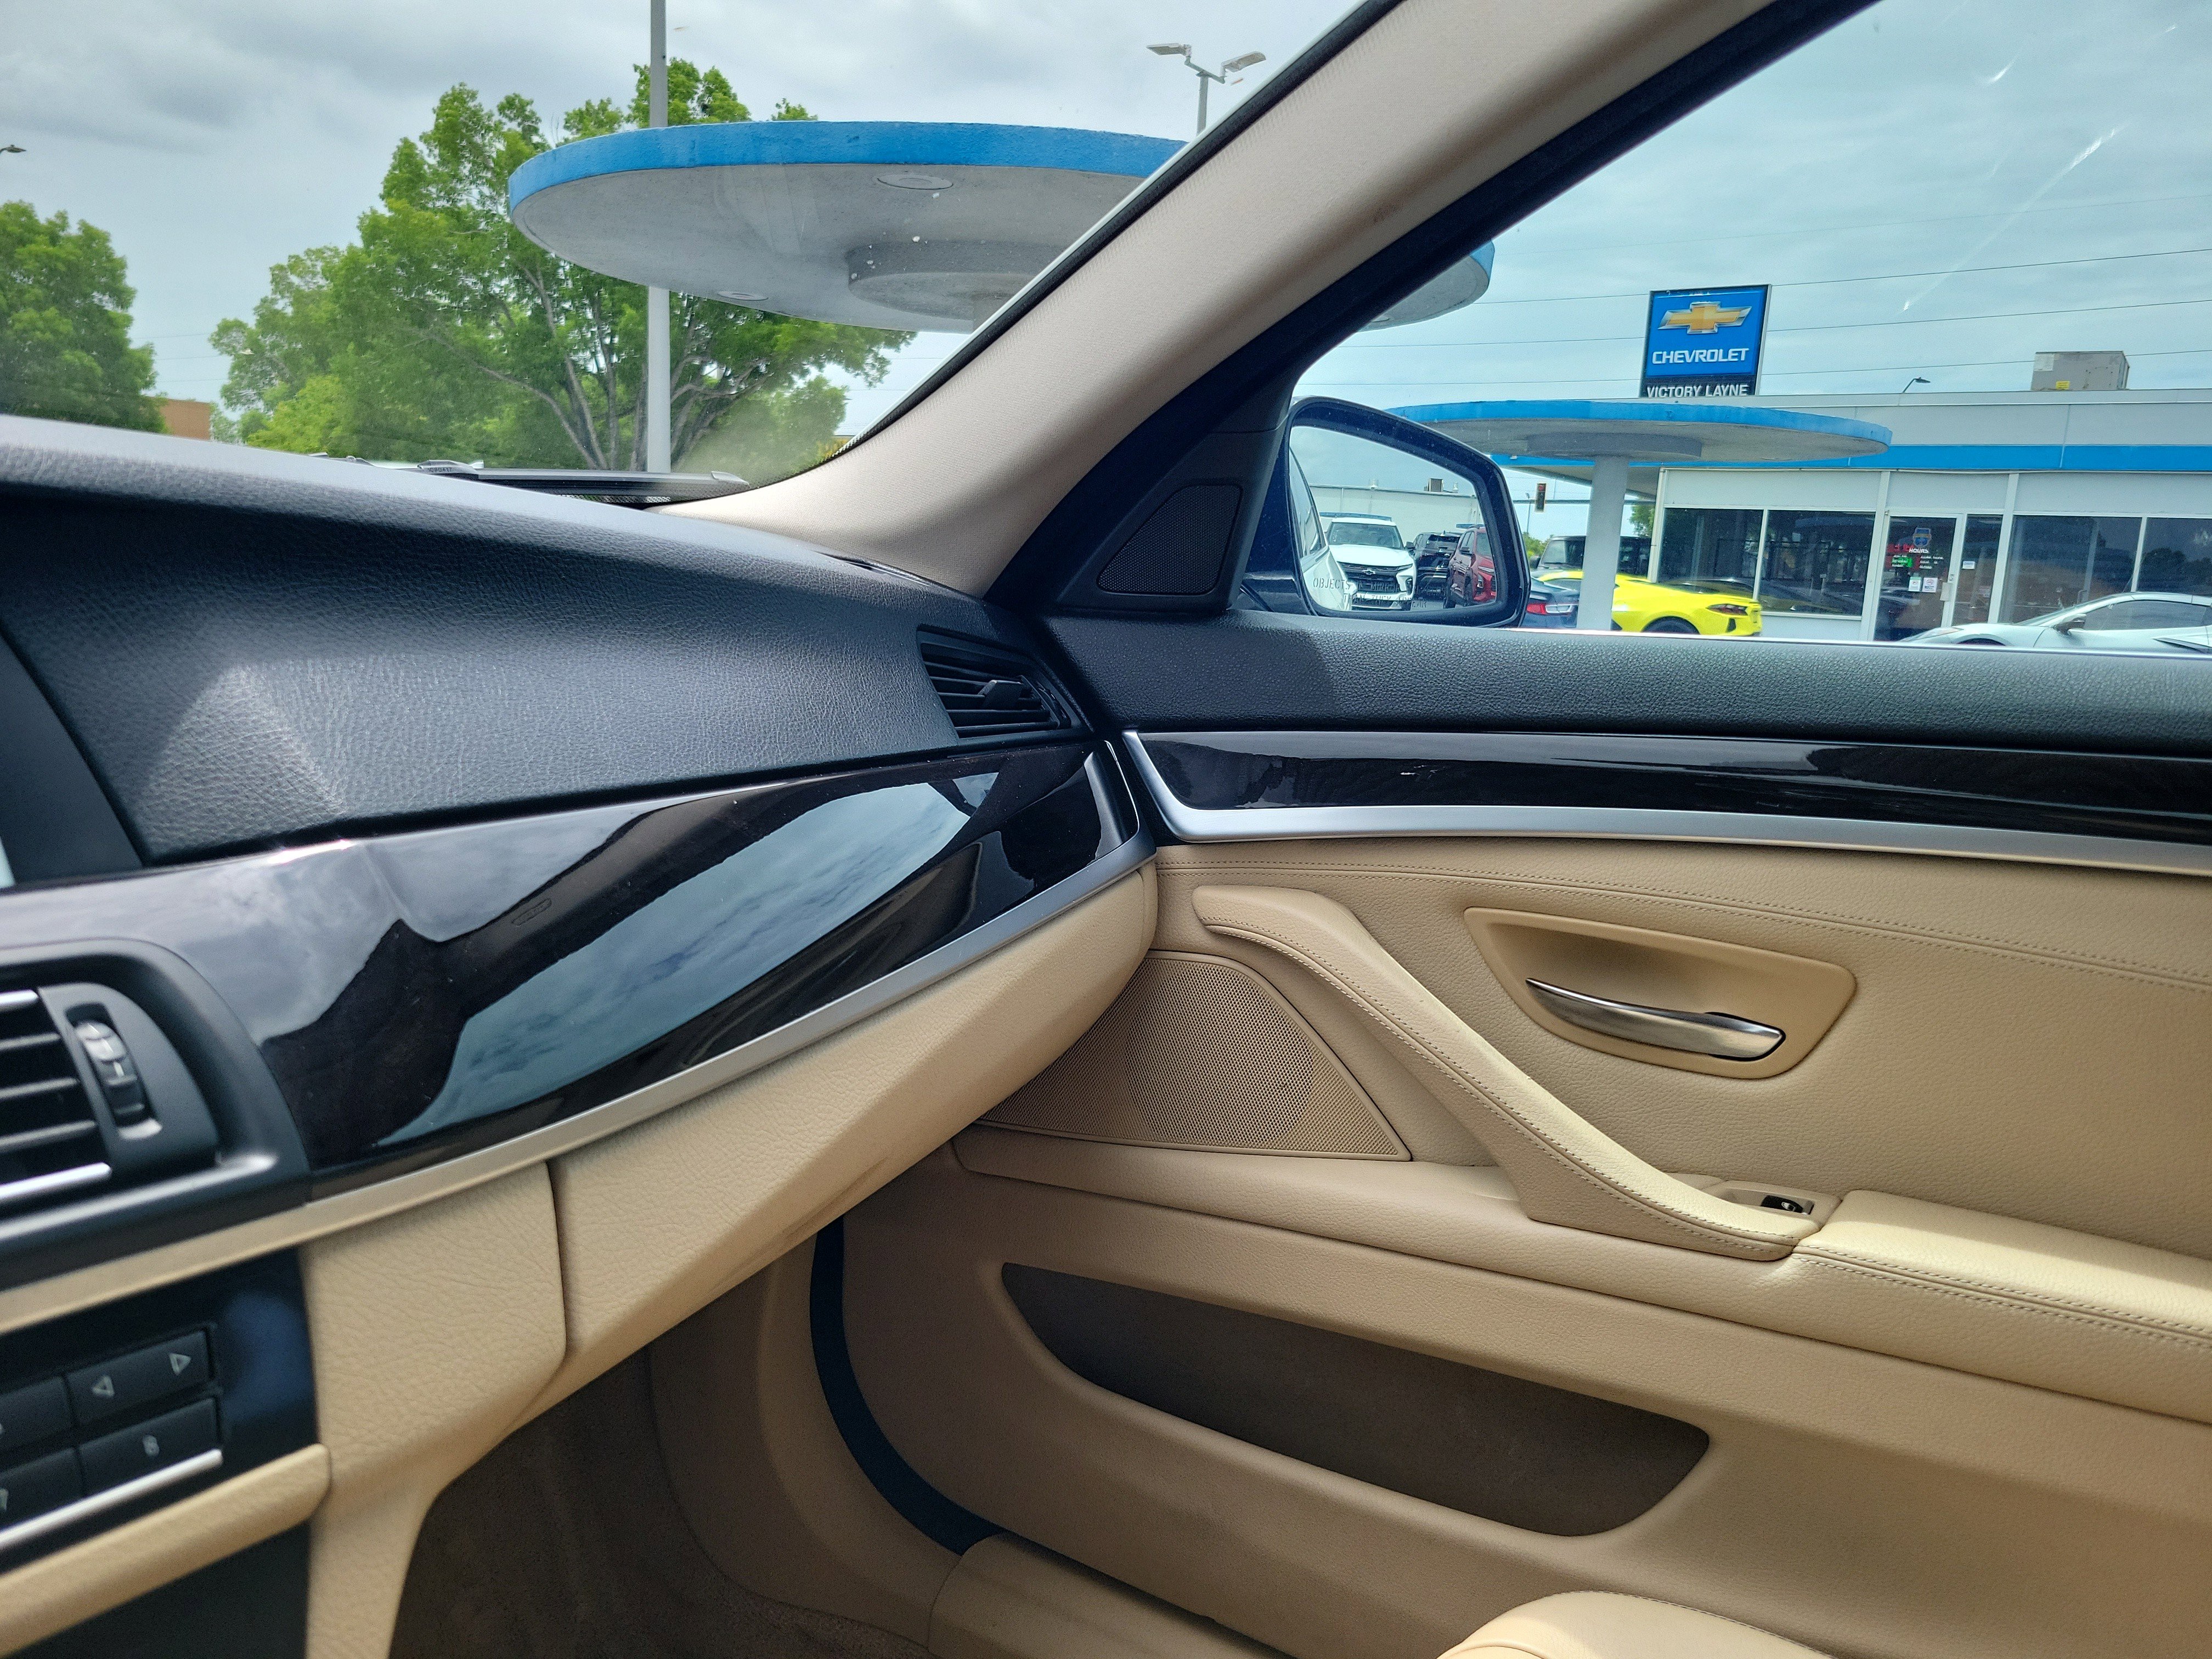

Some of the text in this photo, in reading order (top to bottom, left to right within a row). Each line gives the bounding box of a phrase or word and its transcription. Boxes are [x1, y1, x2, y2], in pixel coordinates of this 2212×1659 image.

[1652, 348, 1750, 364] CHEVROLET
[1646, 384, 1749, 398] VICTORY LAYNE
[1313, 578, 1350, 590] OBJECTS
